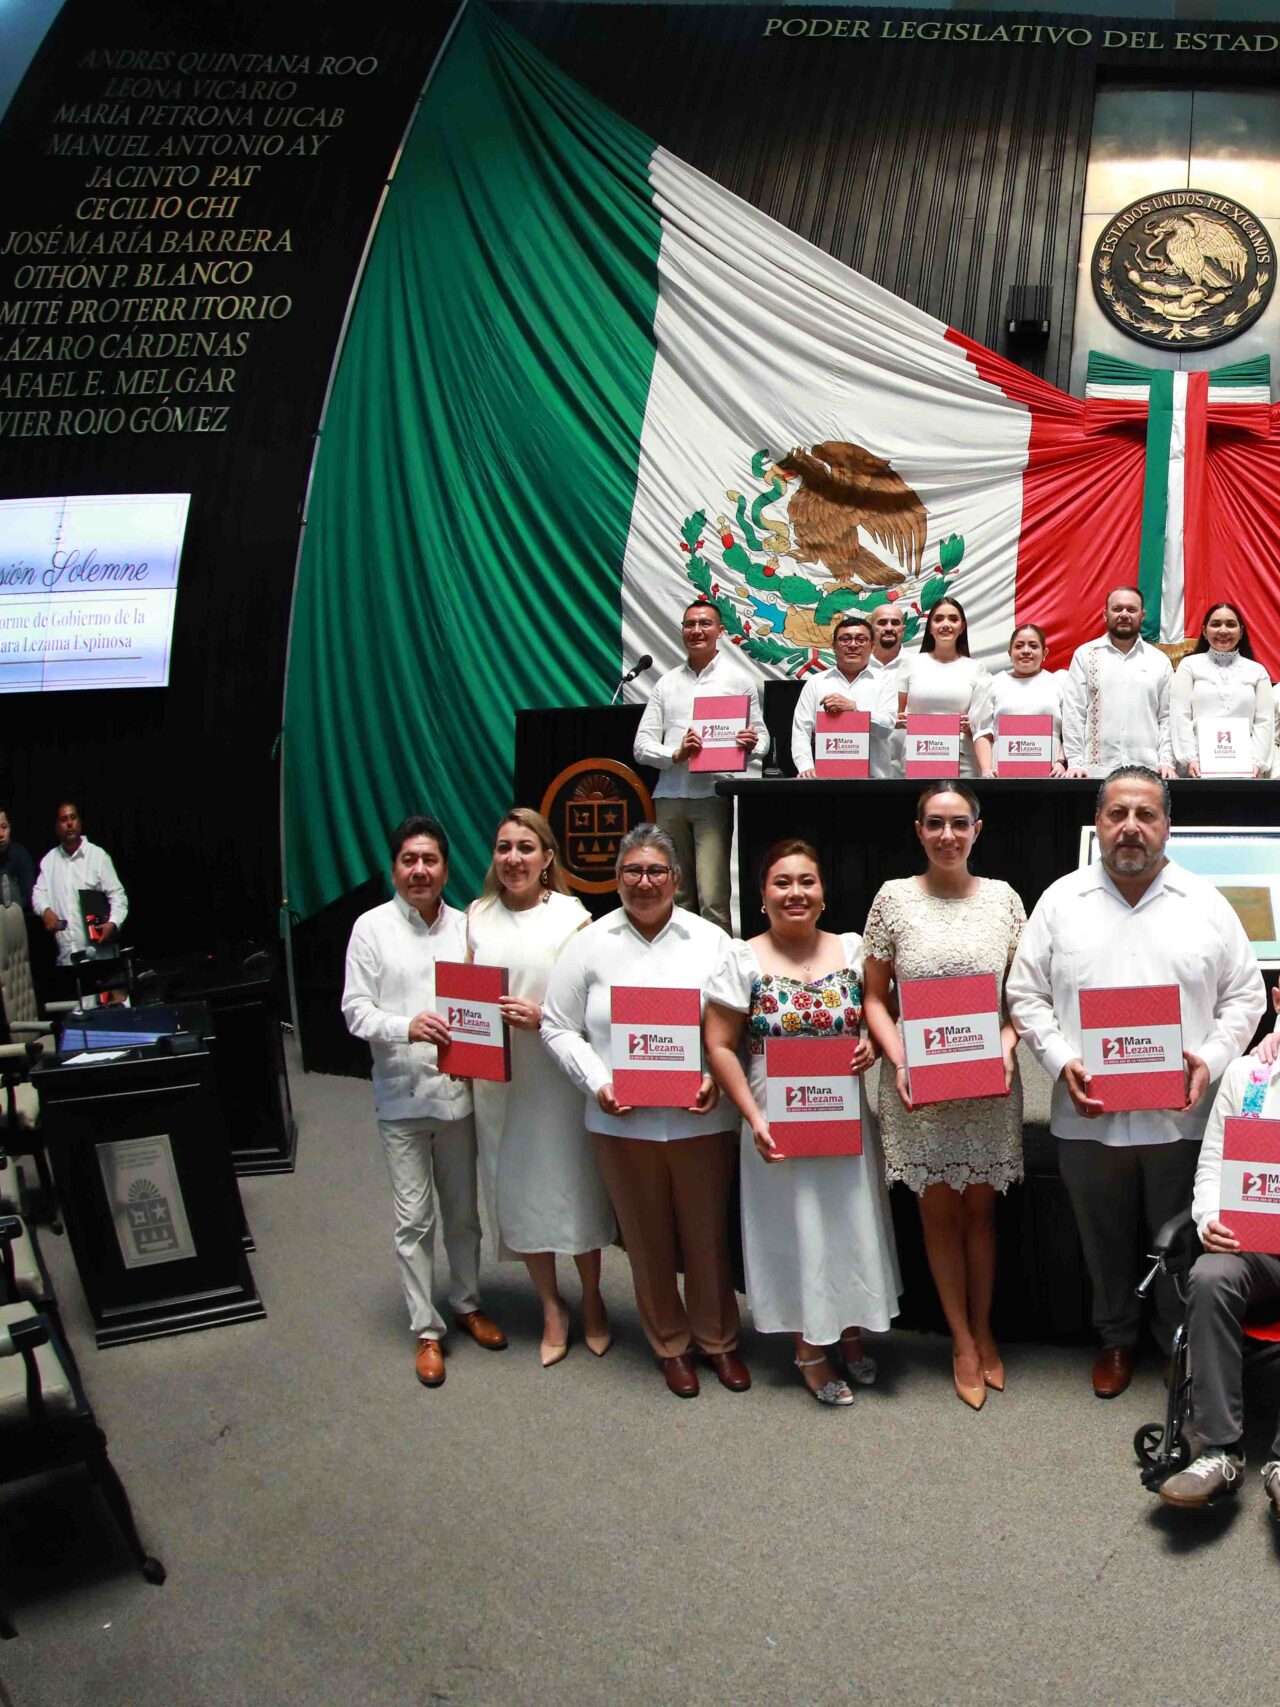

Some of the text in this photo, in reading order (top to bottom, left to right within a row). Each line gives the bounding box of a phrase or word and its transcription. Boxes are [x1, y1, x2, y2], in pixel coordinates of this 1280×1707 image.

[762, 18, 870, 38] PODER
[880, 20, 1092, 46] LEGISLATIVO
[1101, 30, 1163, 50] DEL
[177, 51, 311, 76] QUINTANA
[318, 55, 379, 76] ROO
[104, 77, 297, 101] LEONA VICARIO
[137, 104, 254, 127] PETRONA
[263, 106, 345, 128] UICAB
[45, 133, 332, 157] MANUEL ANTONIO AY
[86, 165, 261, 188] JACINTO PAT
[75, 195, 241, 221] CECILIO CHI
[1, 224, 293, 255] JOSÉ MARÍA BARRERA
[1101, 193, 1271, 265] ESTADOS UNIDOS MEXICANOS
[13, 257, 253, 289] OTHÓN P. BLANCO
[100, 325, 250, 359] CÁRDENAS
[81, 370, 106, 397] E.
[112, 367, 236, 395] MELGAR
[54, 408, 126, 436] ROJO
[129, 396, 232, 434] GÓMEZ
[42, 548, 149, 587] Solemne
[33, 611, 48, 628] de
[51, 609, 111, 627] Gobierno
[114, 607, 130, 625] de
[134, 607, 145, 624] la
[23, 636, 70, 652] Lezama
[73, 632, 132, 653] Espinosa
[463, 1009, 482, 1019] Mara
[463, 1019, 490, 1028] Lezama
[649, 1034, 673, 1044] Mara
[945, 1026, 971, 1035] Mara
[946, 1034, 984, 1044] Lezama
[1124, 1037, 1152, 1045] Mara
[649, 1043, 684, 1053] Lezama
[1125, 1045, 1164, 1054] Lezama
[806, 1086, 832, 1095] Mara
[807, 1094, 844, 1103] Lezama
